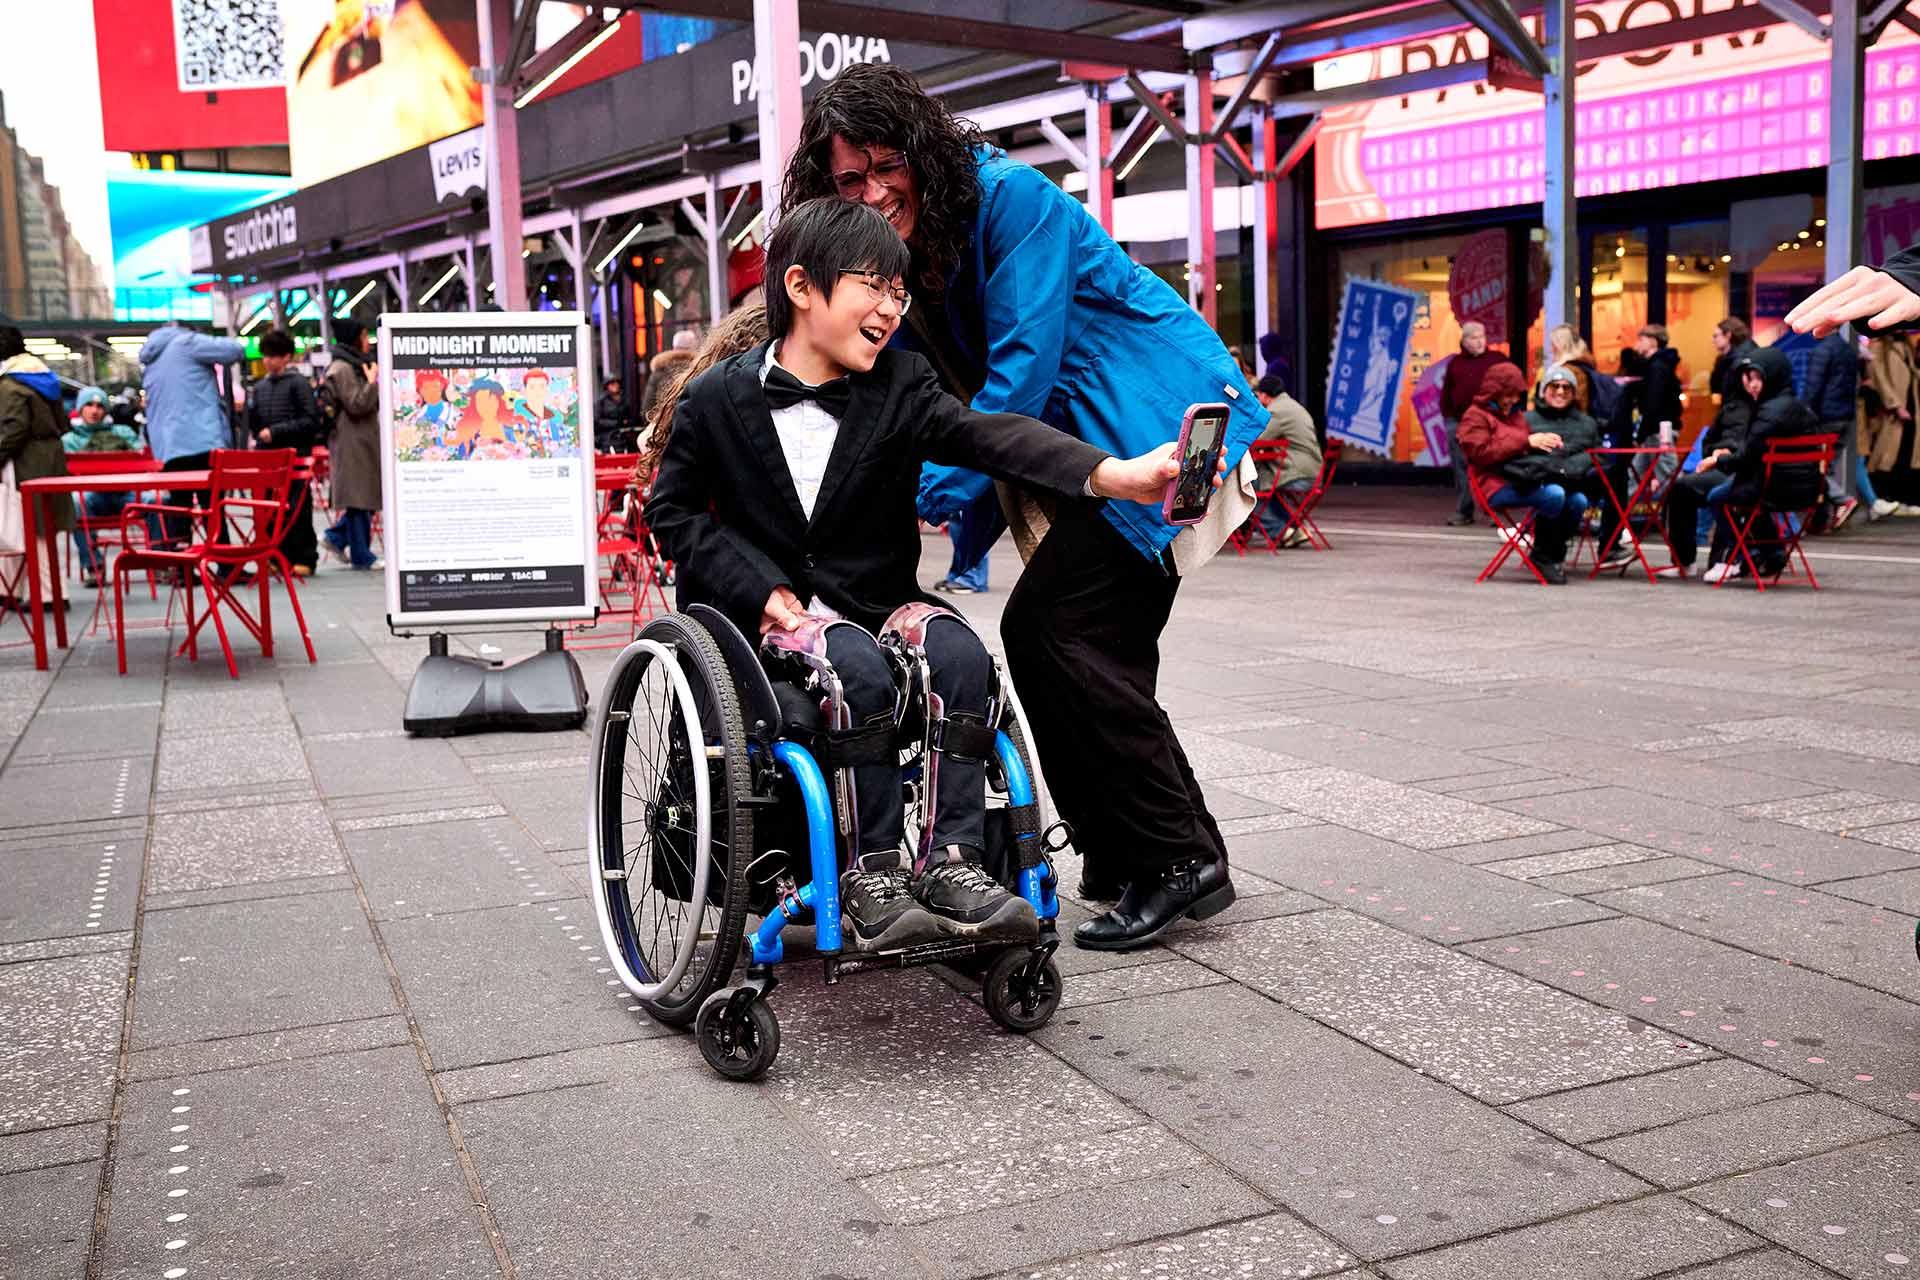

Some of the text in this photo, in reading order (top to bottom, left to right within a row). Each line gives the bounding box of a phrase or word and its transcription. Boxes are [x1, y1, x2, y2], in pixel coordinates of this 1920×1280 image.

[489, 333, 572, 354] MOMENT
[1334, 291, 1367, 410] NEW YORK
[429, 355, 538, 366] Presented by Times Square Arts
